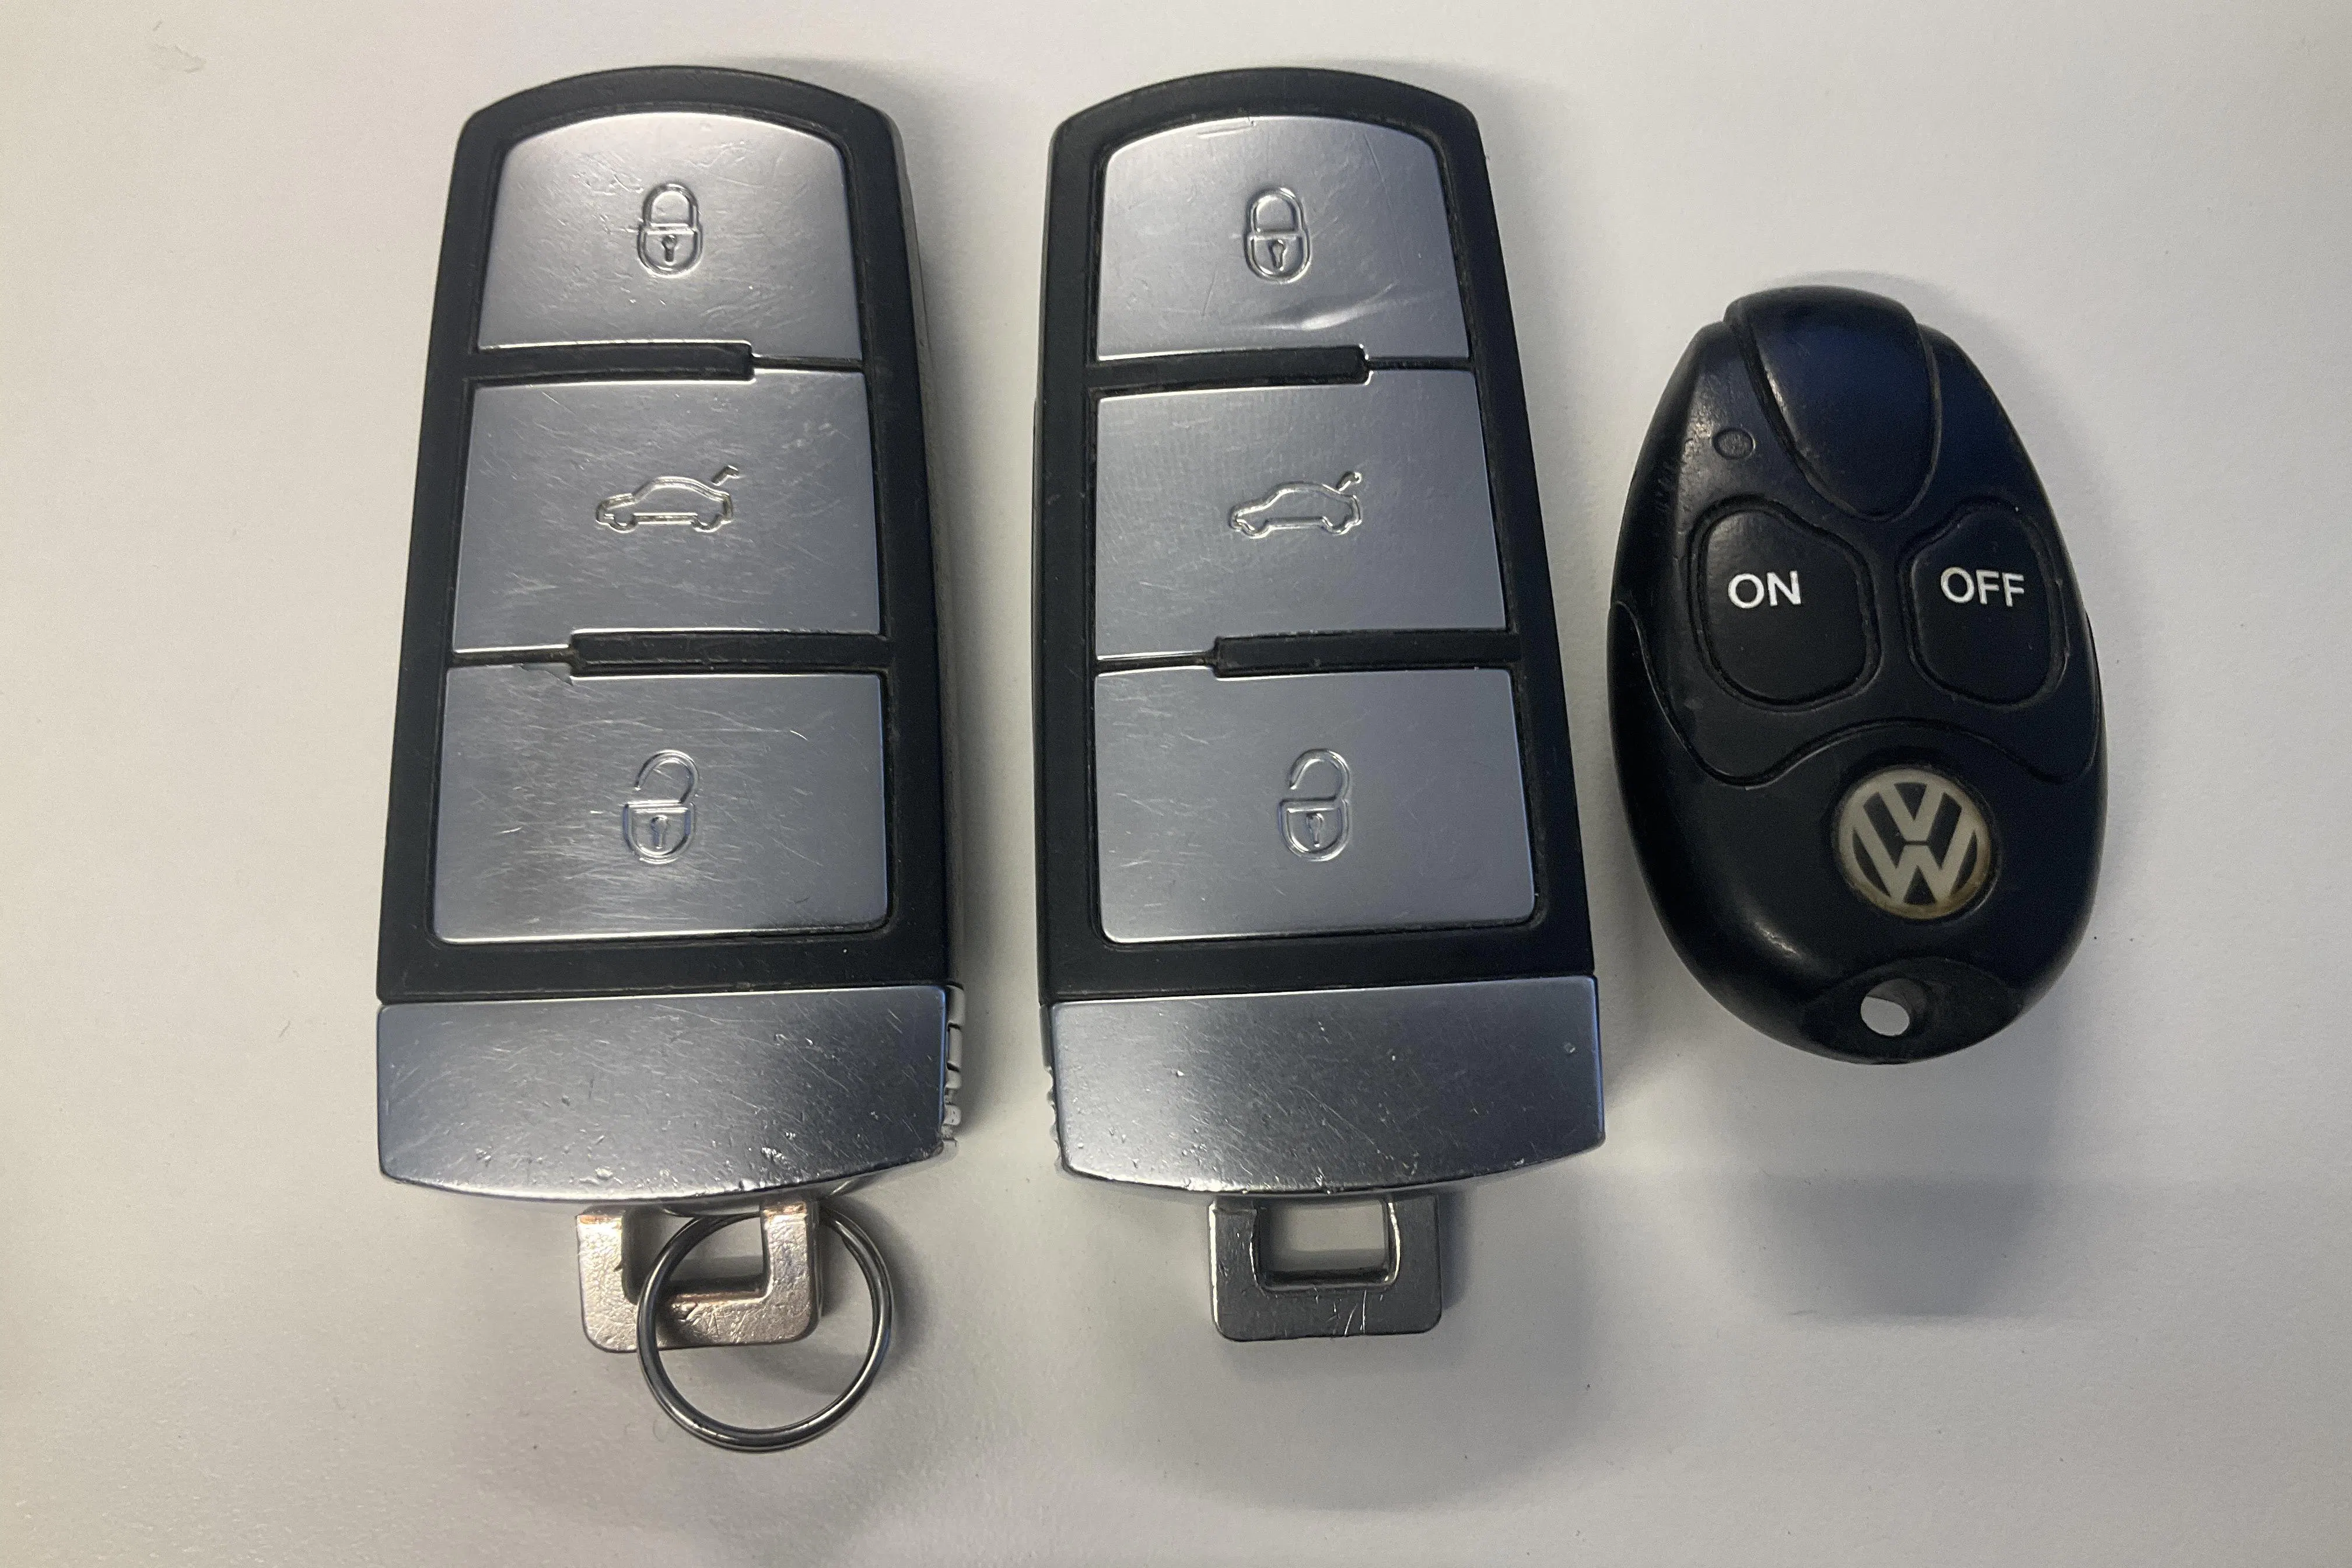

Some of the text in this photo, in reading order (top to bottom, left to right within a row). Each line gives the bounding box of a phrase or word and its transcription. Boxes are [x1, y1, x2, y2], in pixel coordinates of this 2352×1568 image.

[1727, 570, 1801, 609] ON
[1940, 566, 2025, 607] OFF
[1843, 773, 1986, 911] VW
